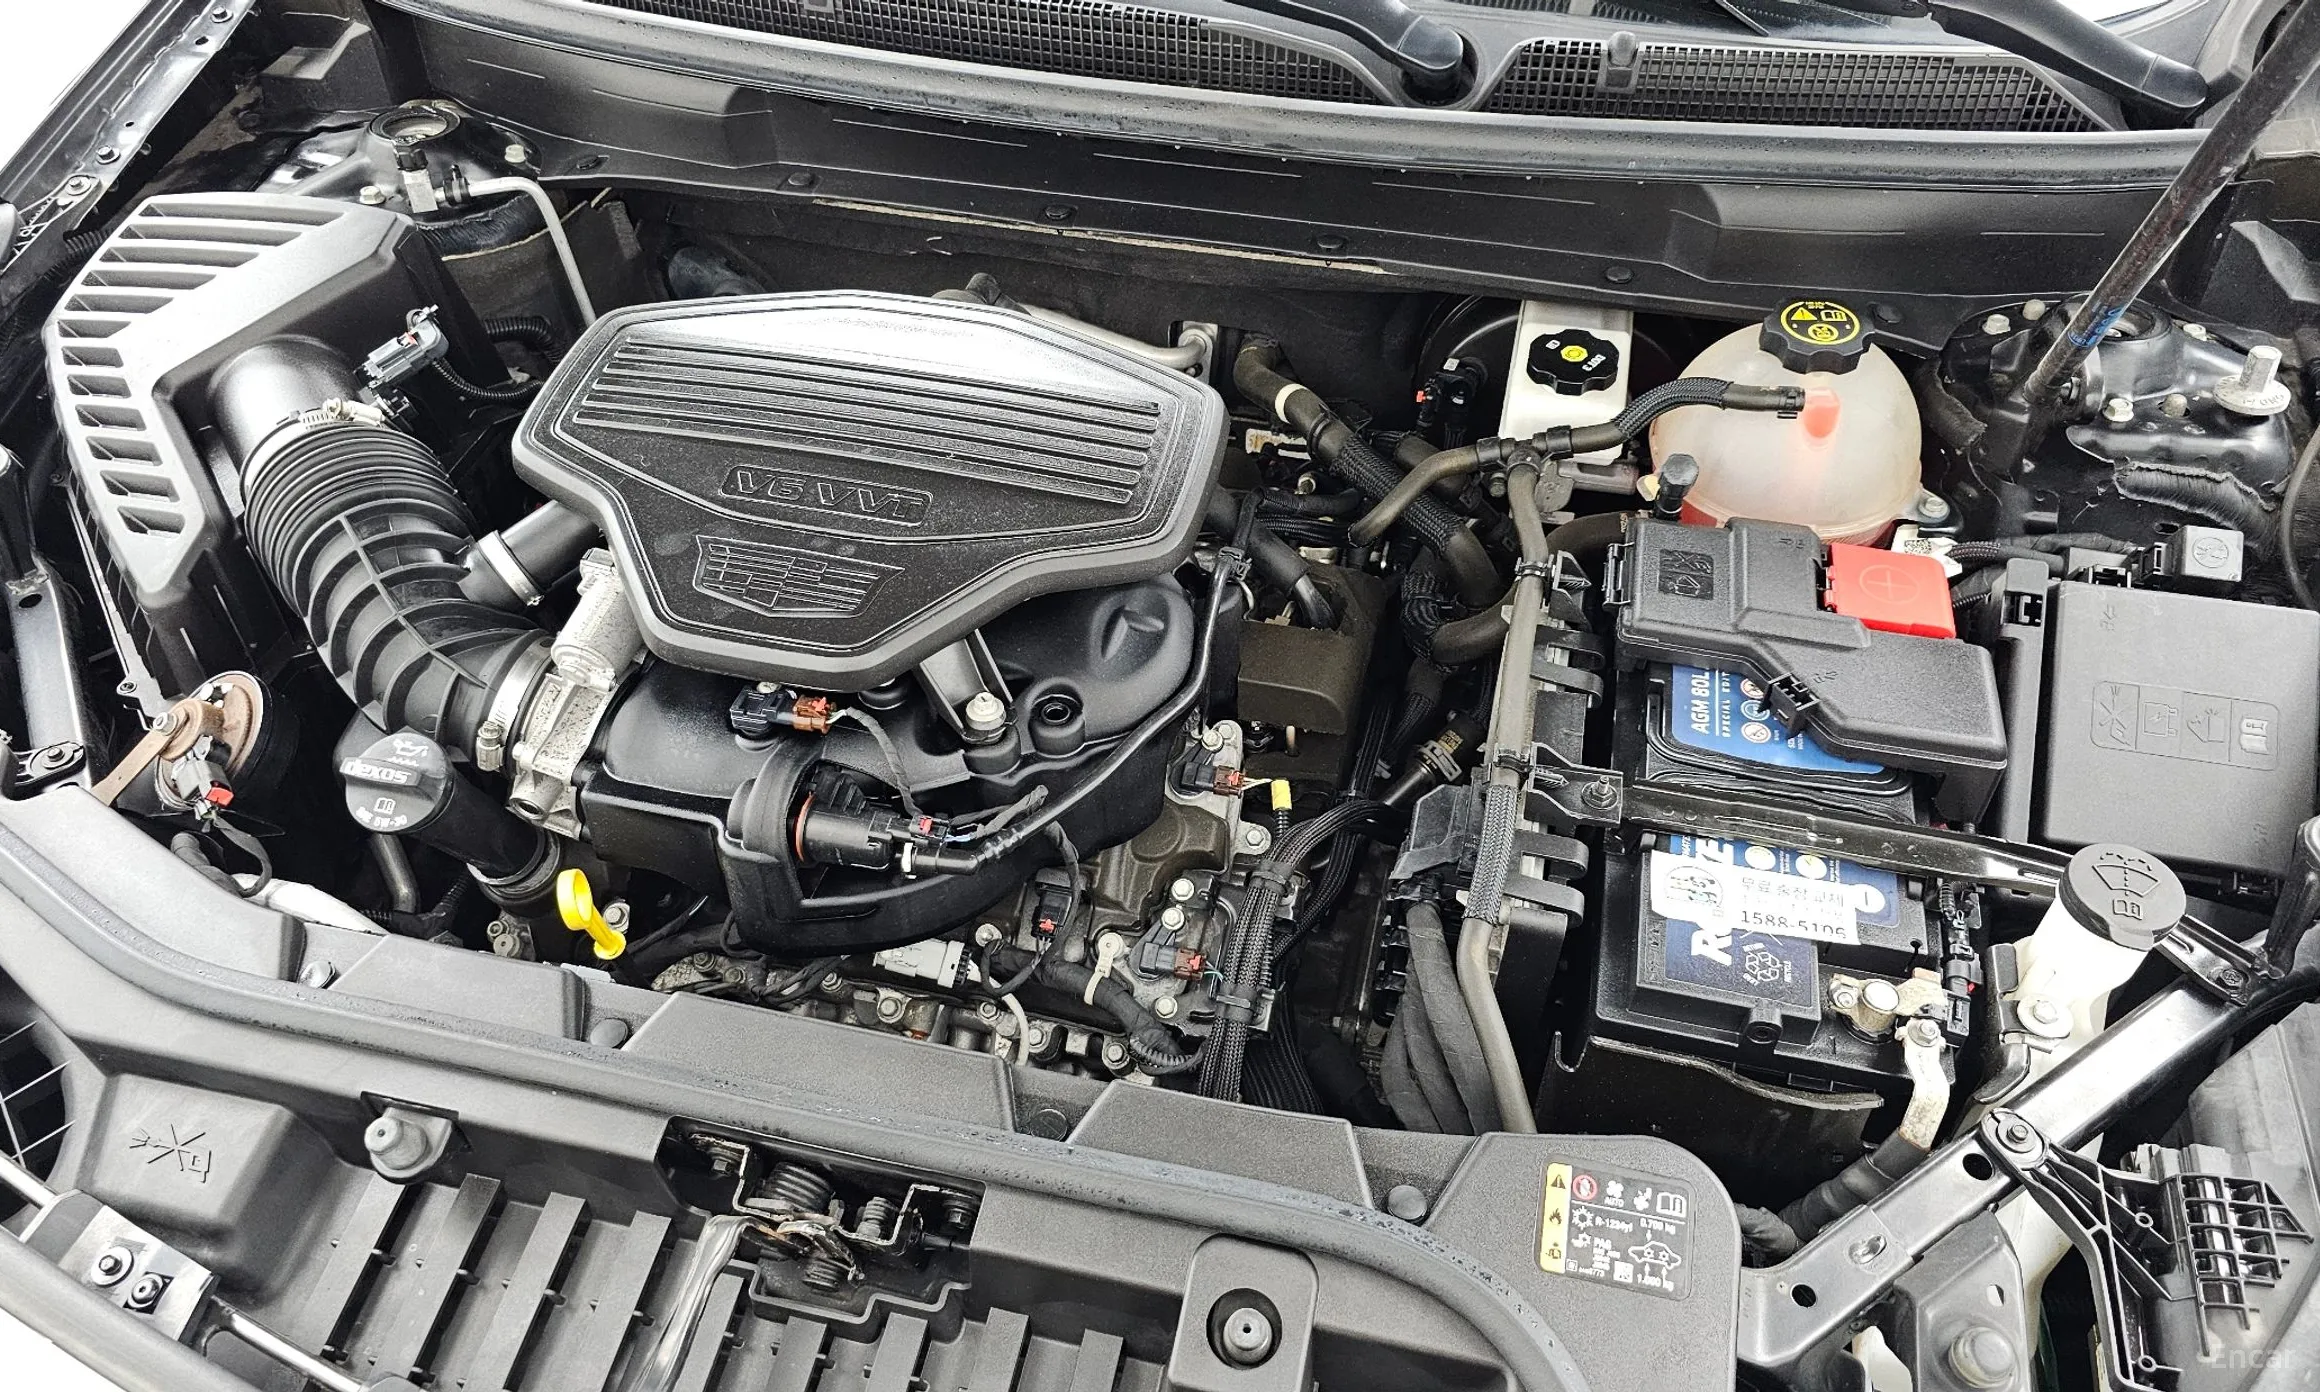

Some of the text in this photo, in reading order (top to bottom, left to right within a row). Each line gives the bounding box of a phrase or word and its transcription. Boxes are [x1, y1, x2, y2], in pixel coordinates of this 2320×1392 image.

[737, 470, 925, 518] V6 VVT
[1691, 704, 1711, 735] AGM
[1721, 699, 1732, 738] SPECIAL
[343, 759, 412, 785] dexos
